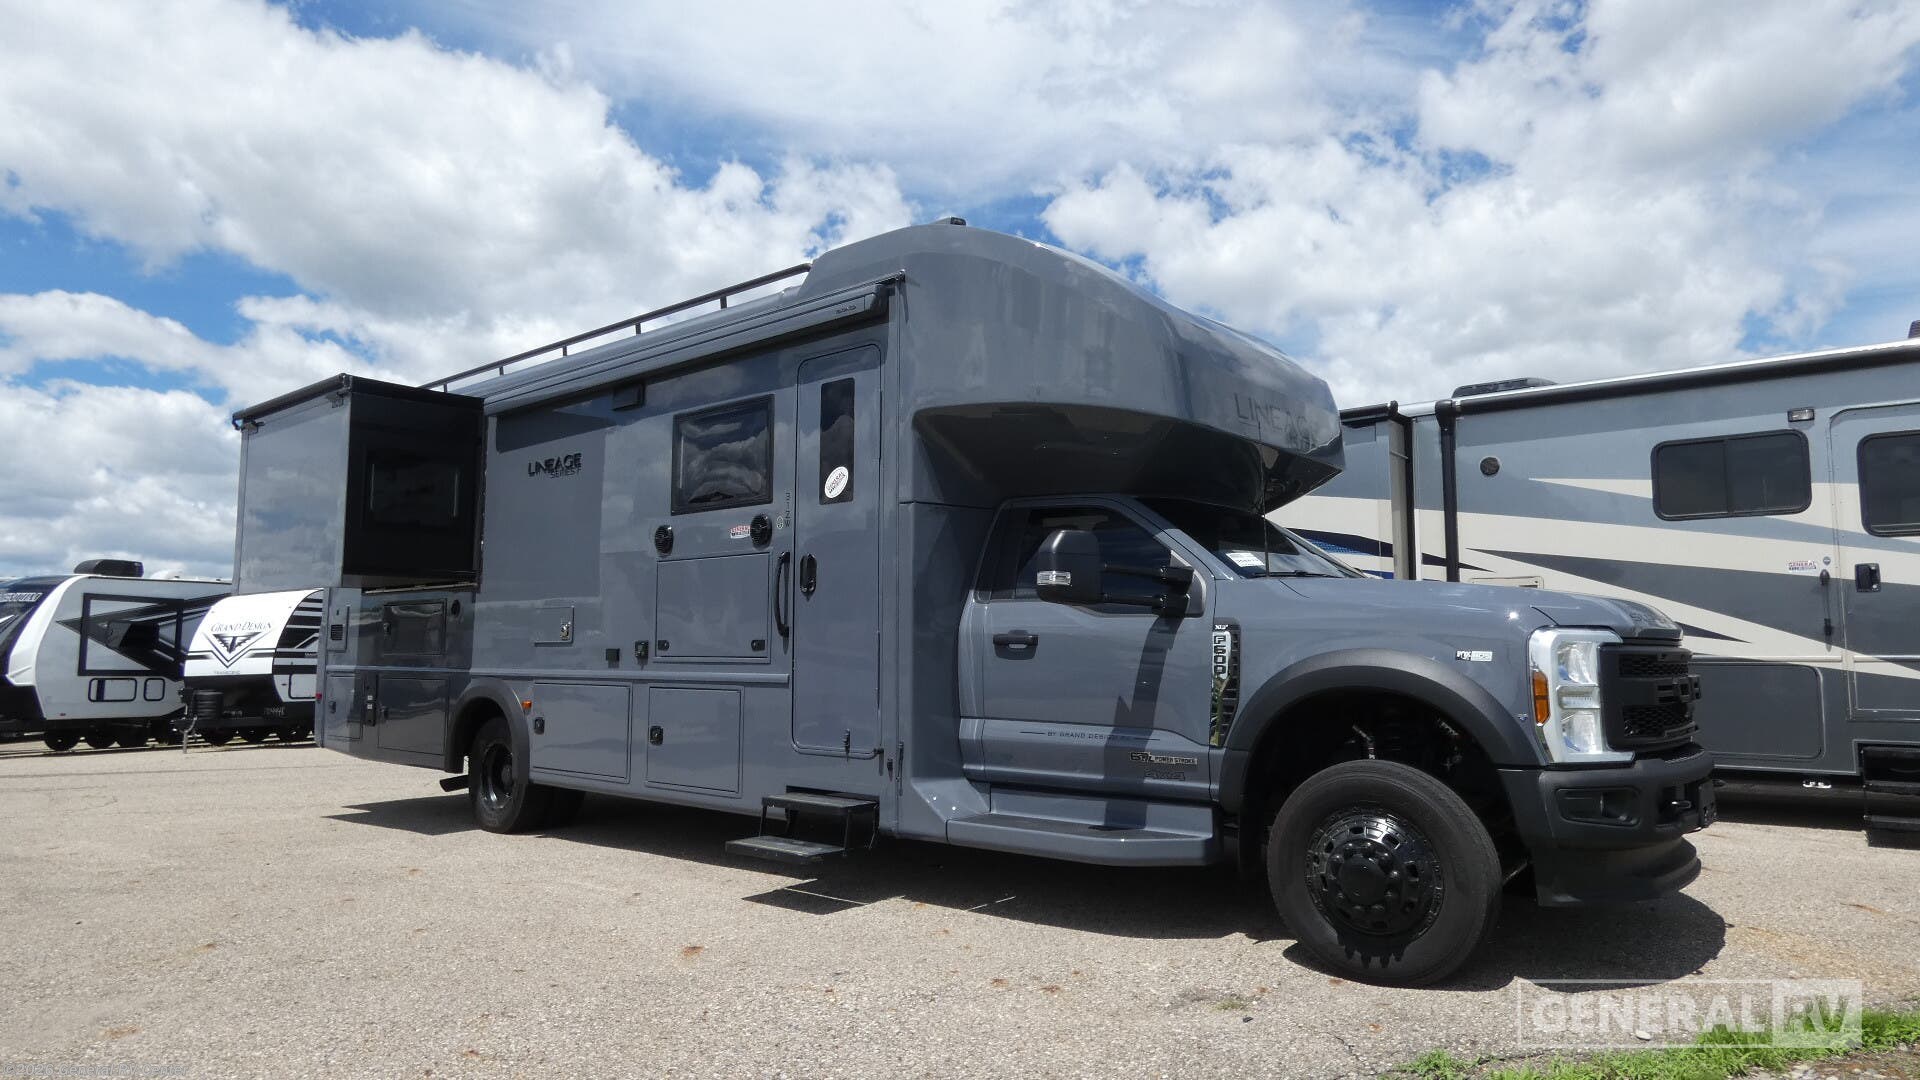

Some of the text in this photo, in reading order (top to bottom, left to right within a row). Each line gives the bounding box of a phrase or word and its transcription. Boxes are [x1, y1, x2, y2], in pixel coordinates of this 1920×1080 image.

[528, 453, 582, 477] LINEAGE
[210, 621, 272, 632] GRAND DESIGN
[1059, 732, 1086, 740] GRAND
